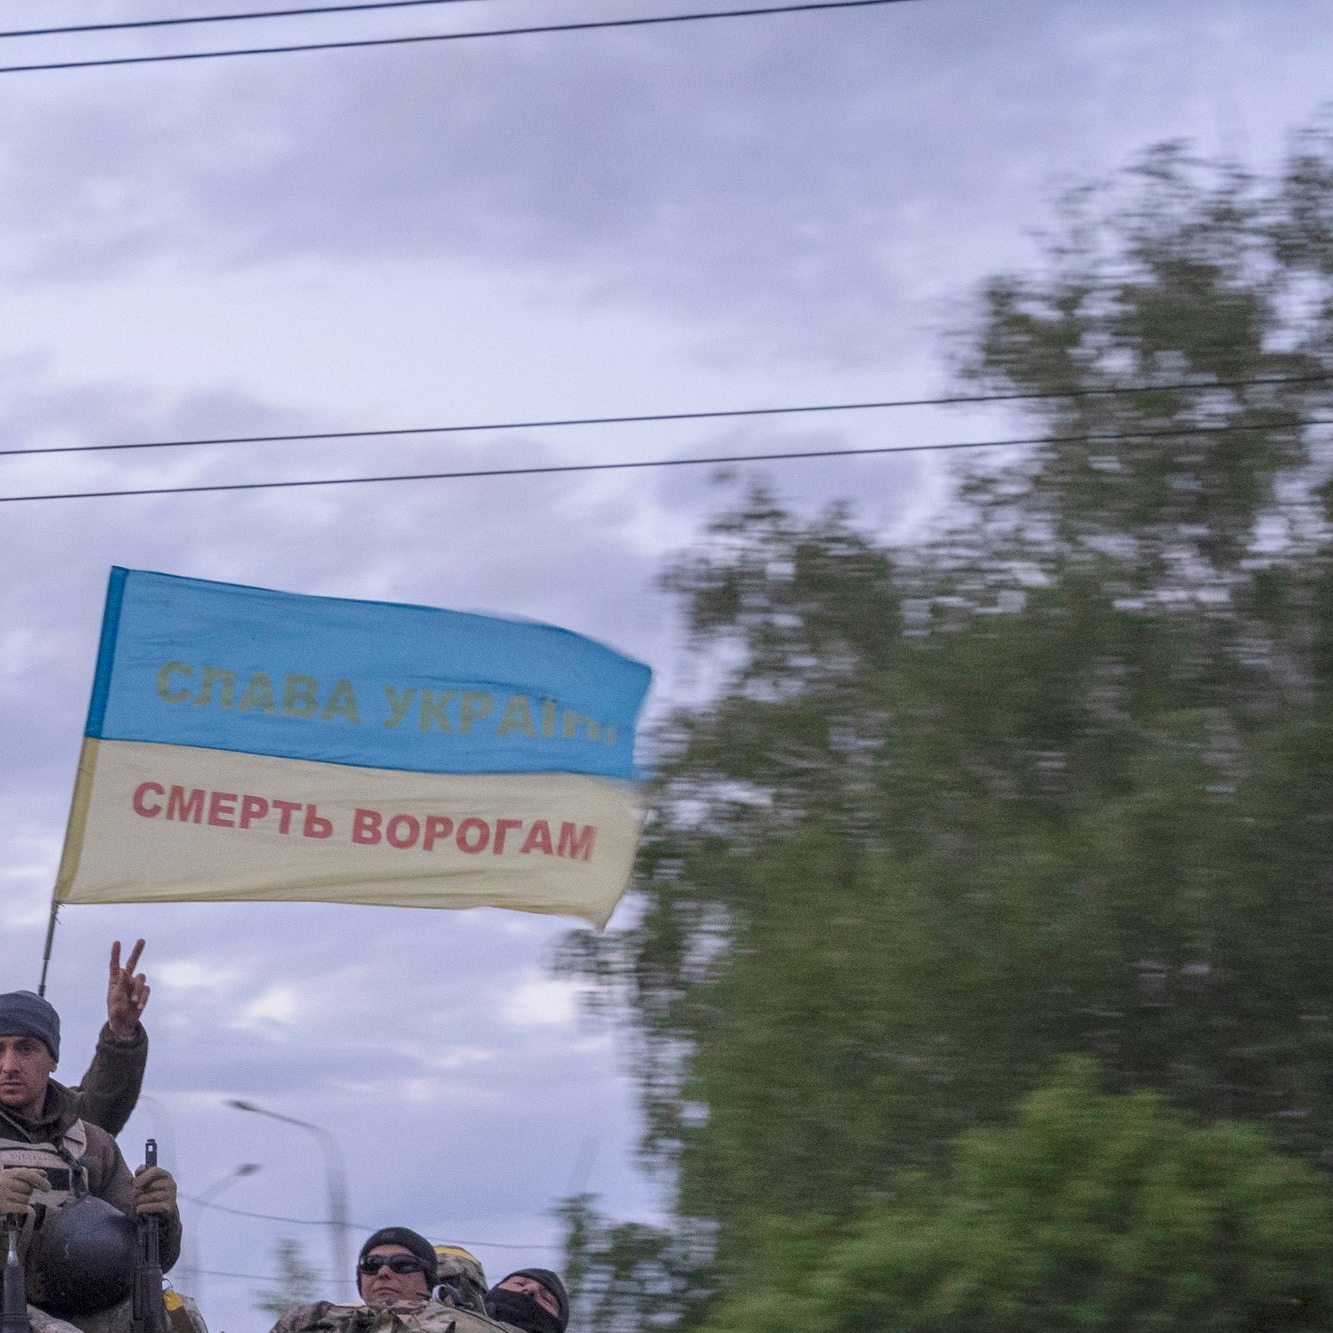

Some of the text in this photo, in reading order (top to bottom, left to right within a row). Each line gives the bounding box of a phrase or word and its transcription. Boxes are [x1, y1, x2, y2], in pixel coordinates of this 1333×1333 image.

[155, 660, 361, 726] СЛАВА
[132, 781, 598, 862] СМЕРТЬ ВОРОГАМ
